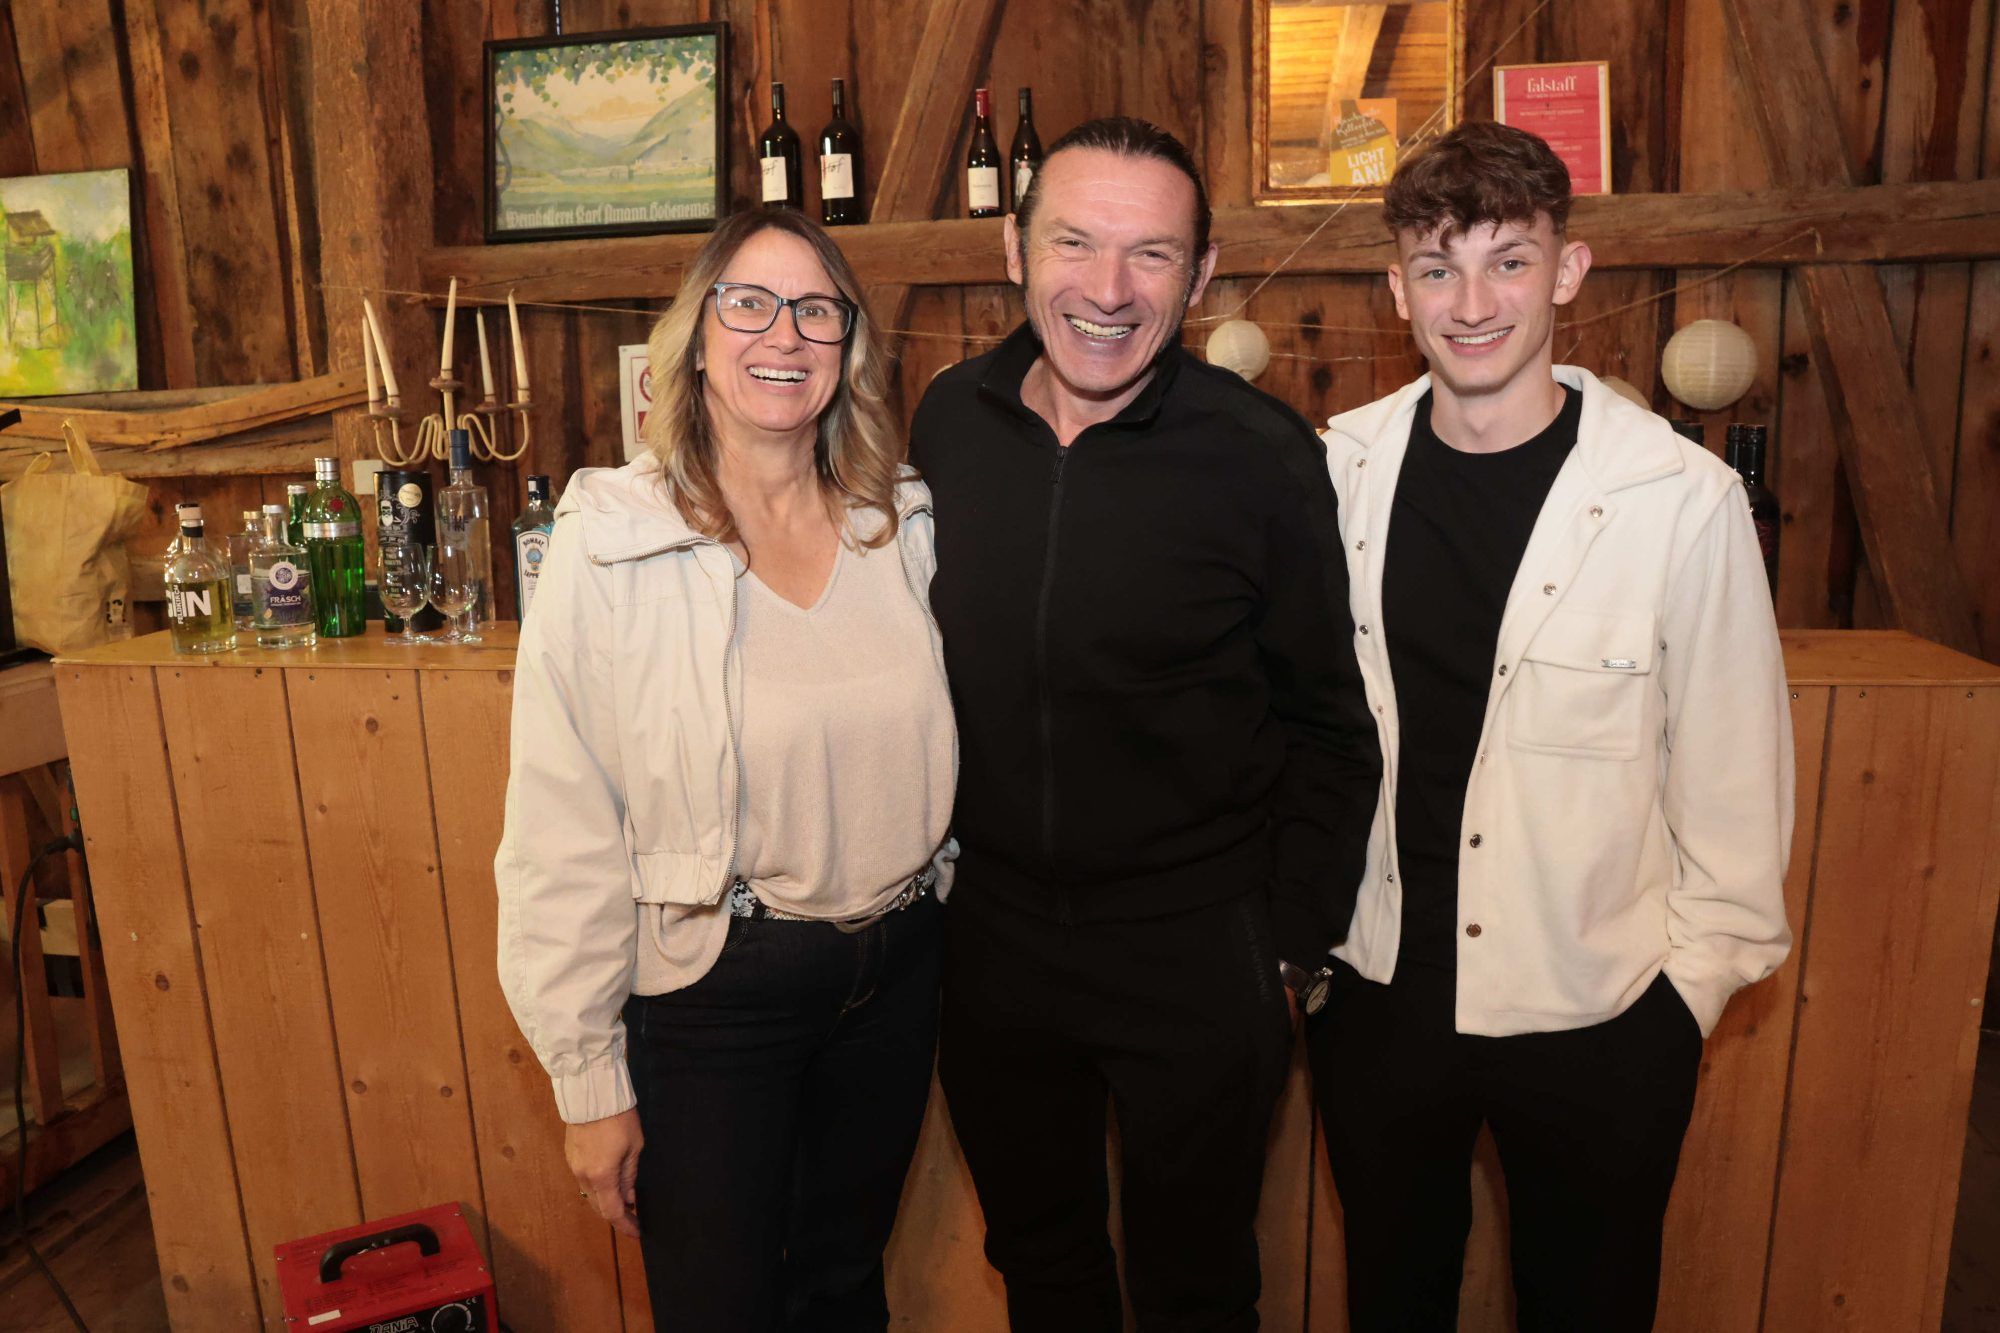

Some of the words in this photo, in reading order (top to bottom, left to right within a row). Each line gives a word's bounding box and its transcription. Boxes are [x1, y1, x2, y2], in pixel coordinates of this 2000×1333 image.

[1527, 76, 1577, 93] falstaff
[1347, 147, 1384, 168] LICHT
[1351, 162, 1388, 185] AN!
[522, 536, 545, 548] BOMBAY
[173, 584, 184, 625] FELDKIRCH
